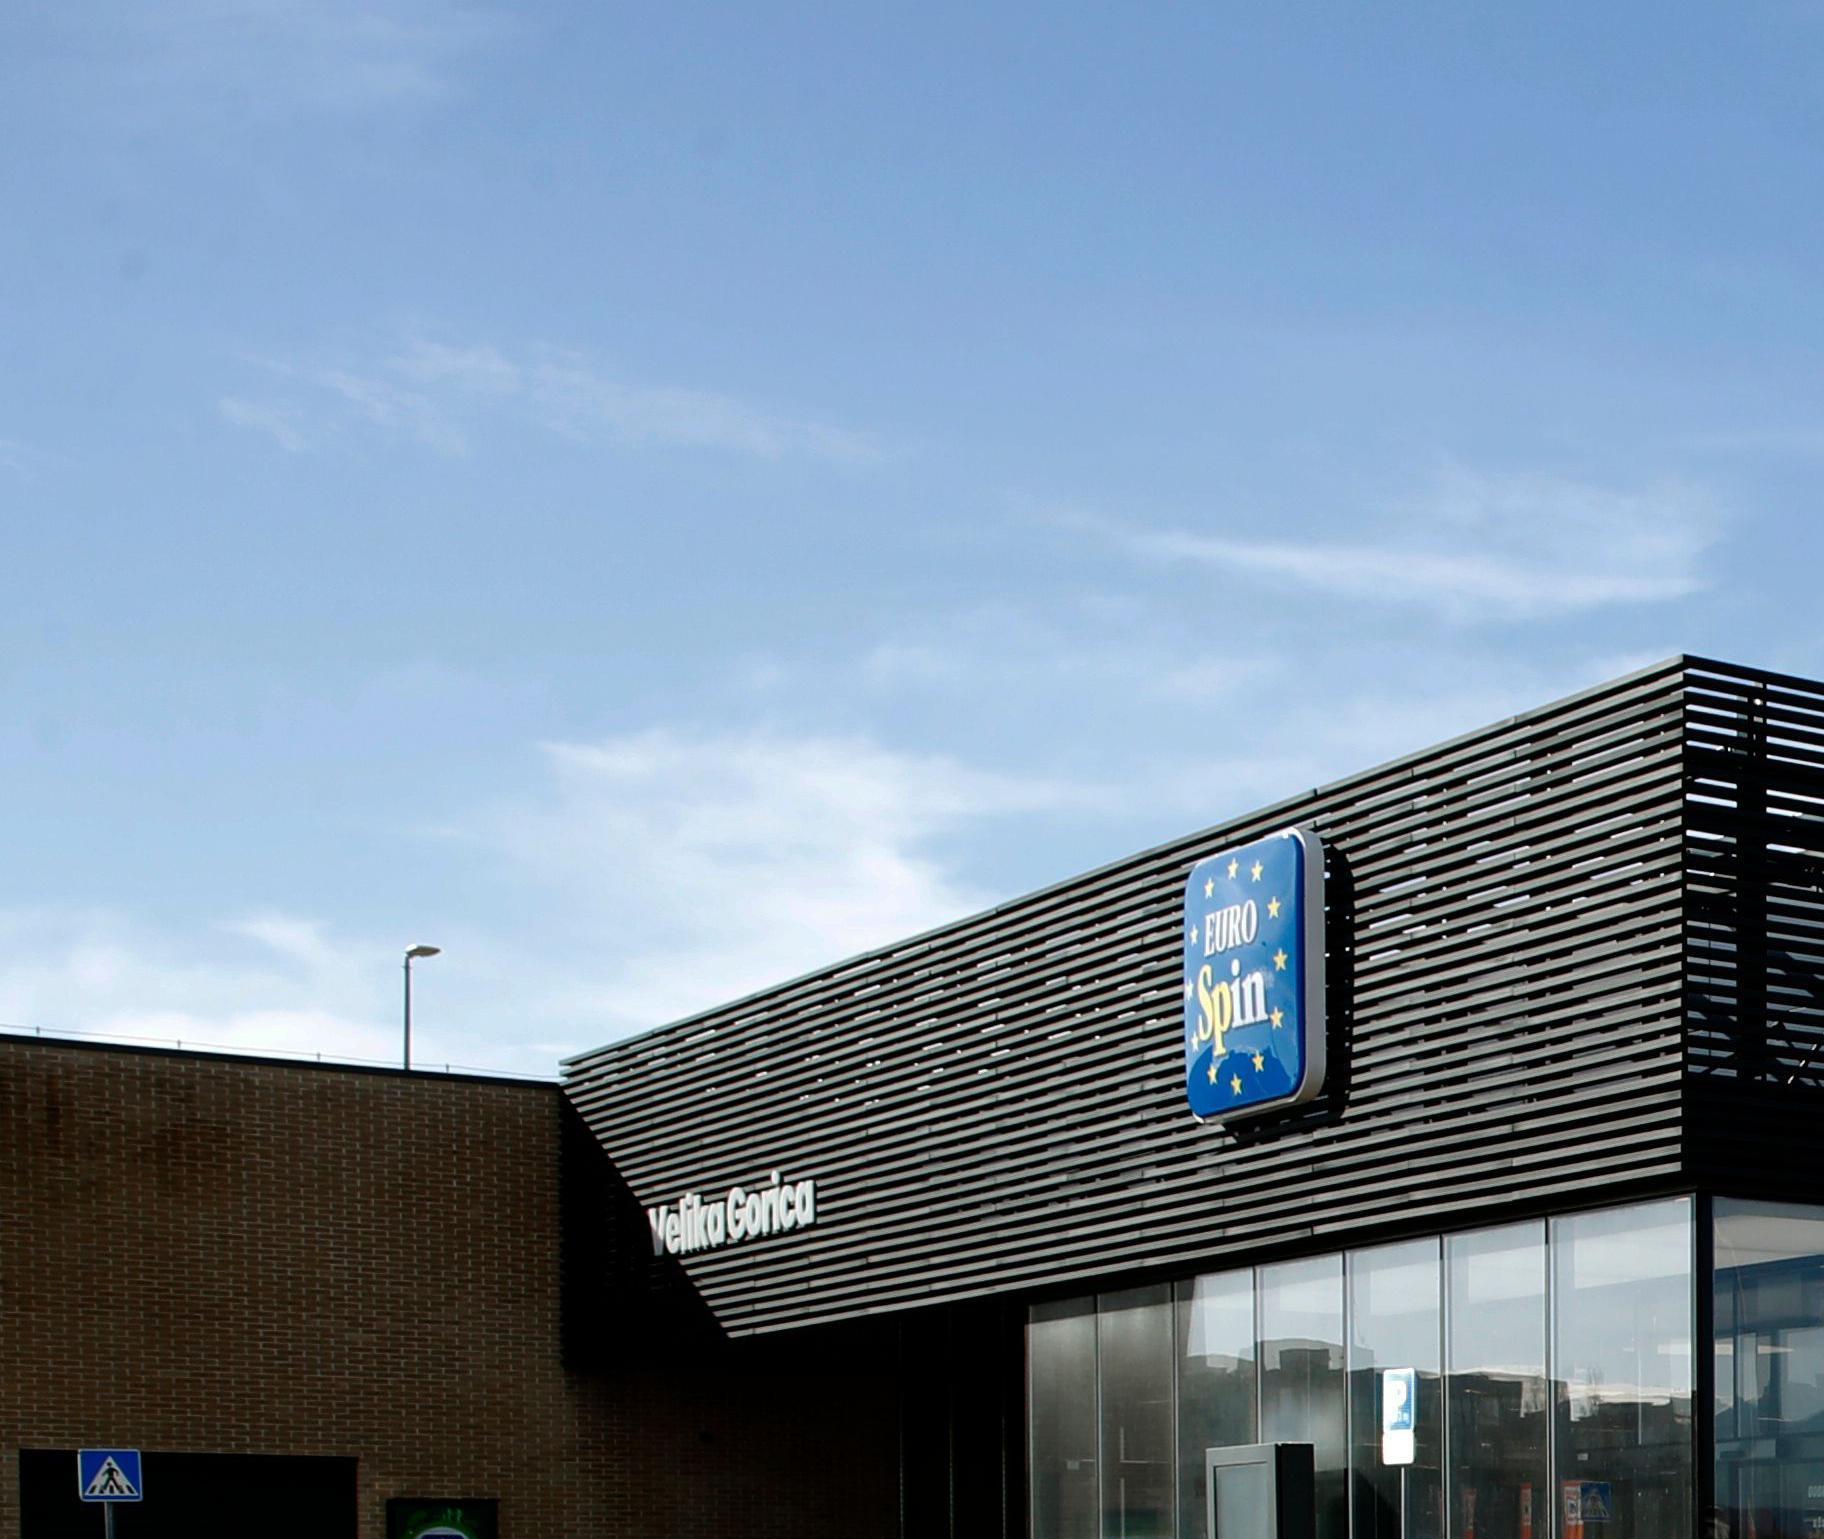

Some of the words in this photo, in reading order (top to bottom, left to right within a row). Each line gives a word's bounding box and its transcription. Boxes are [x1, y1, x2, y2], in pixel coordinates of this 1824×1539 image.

[1204, 899, 1258, 956] EURO
[1197, 959, 1268, 1056] Spin
[649, 1192, 725, 1256] Velika
[727, 1170, 815, 1241] Gorica
